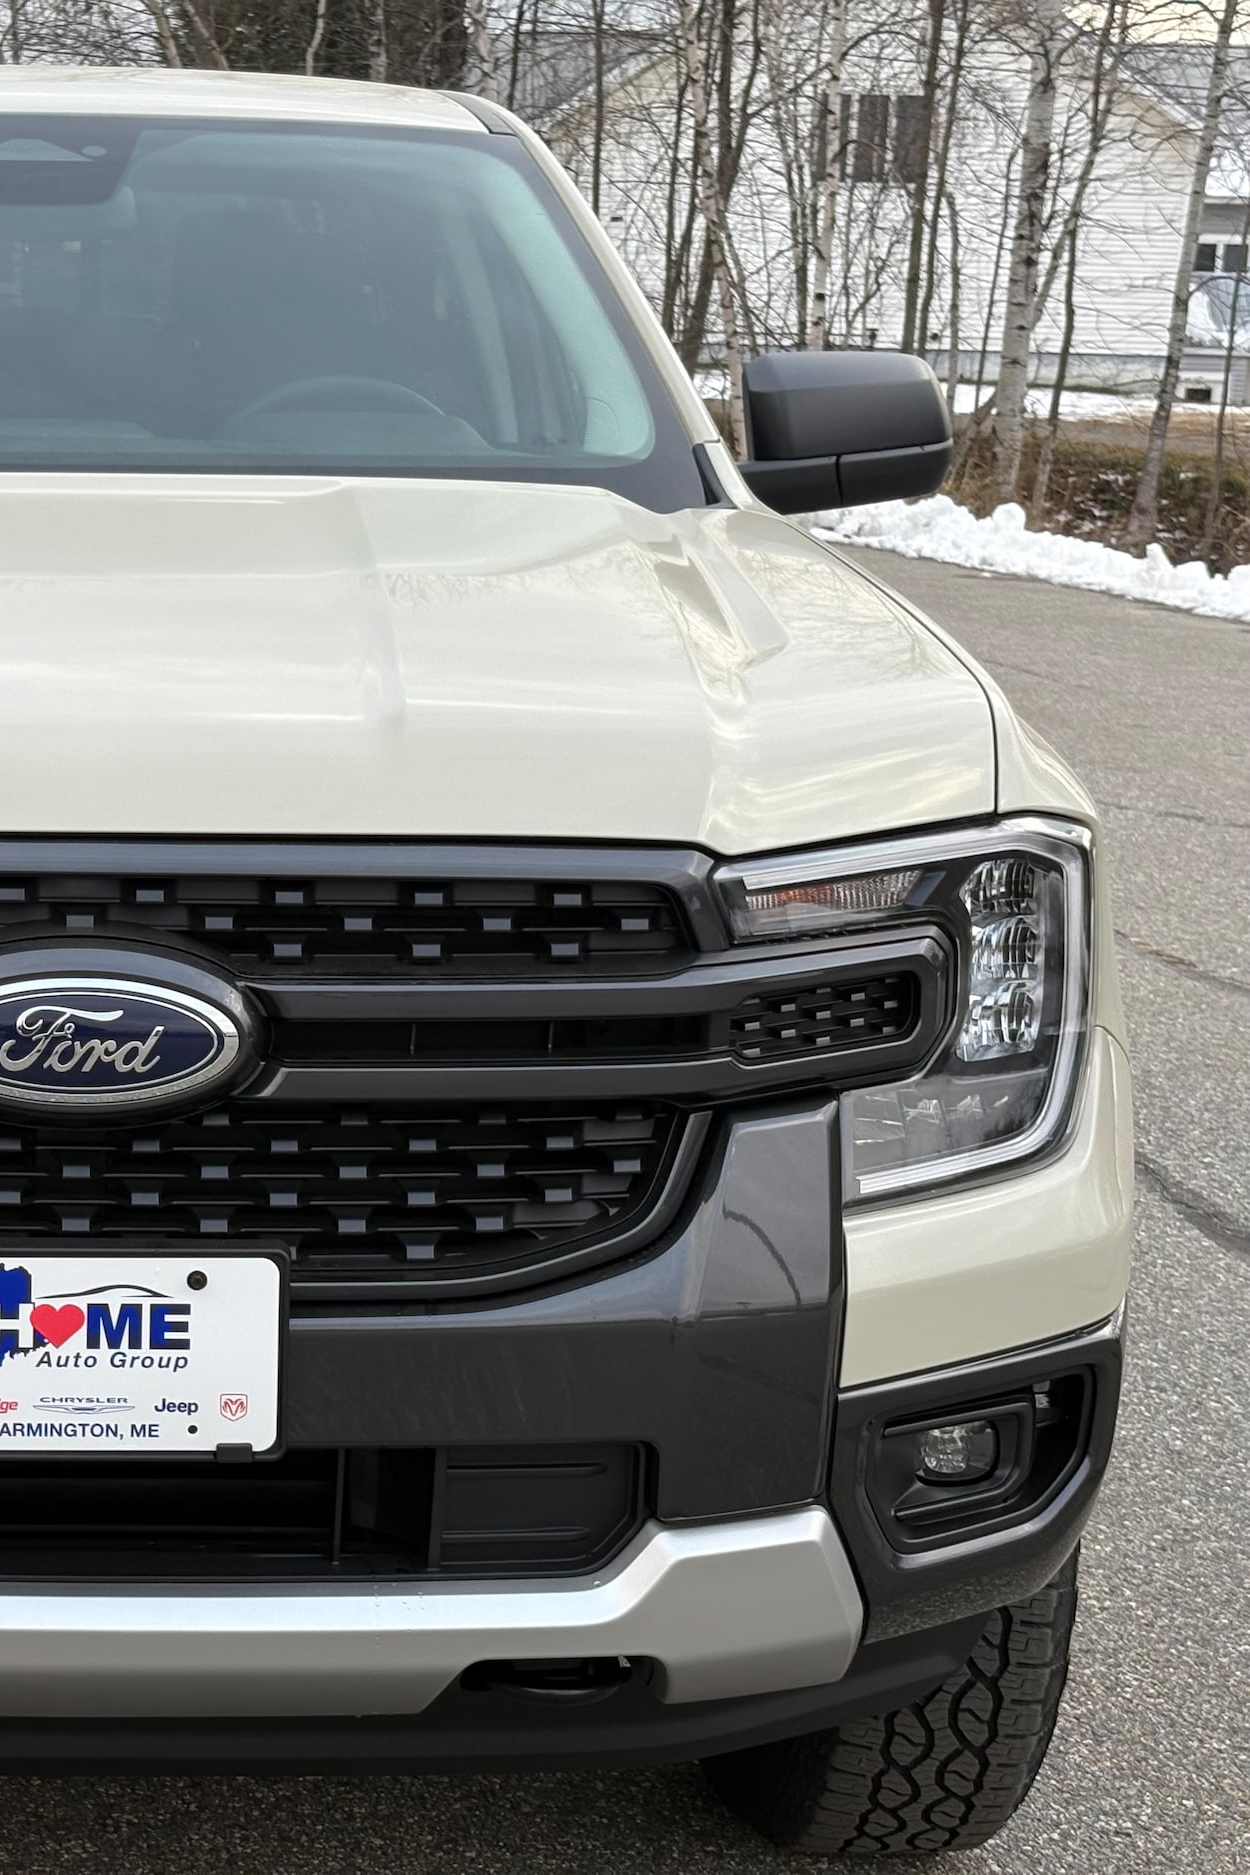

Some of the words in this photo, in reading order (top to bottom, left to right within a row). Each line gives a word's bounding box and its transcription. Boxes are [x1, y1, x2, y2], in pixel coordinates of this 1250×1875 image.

[0, 1005, 165, 1073] Ford
[35, 1352, 97, 1368] Auto
[110, 1352, 188, 1372] Group
[39, 1396, 129, 1404] CHRYSLER
[154, 1398, 199, 1416] Jeep
[130, 1423, 160, 1438] ME
